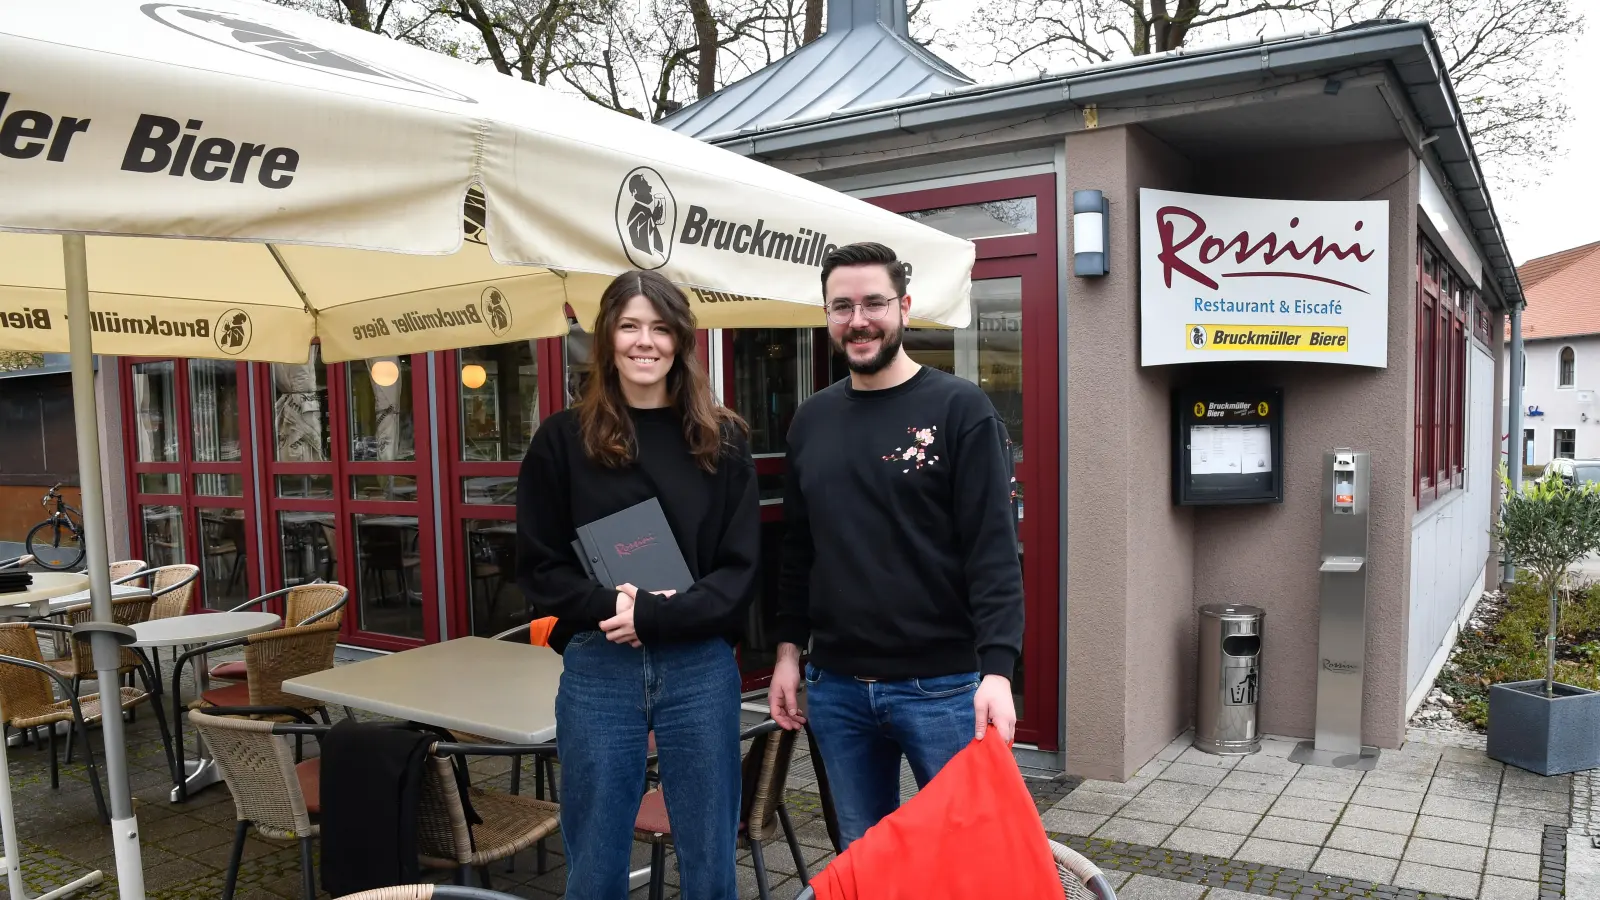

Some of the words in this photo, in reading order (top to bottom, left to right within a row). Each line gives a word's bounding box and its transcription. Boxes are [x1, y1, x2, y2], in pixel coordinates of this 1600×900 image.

[120, 113, 300, 190] Biere
[1156, 205, 1375, 291] Rossini
[1194, 297, 1275, 313] Restaurant
[1279, 300, 1290, 314] &
[1295, 299, 1342, 315] Eiscafé
[1212, 330, 1302, 346] Bruckmüller
[1309, 332, 1347, 347] Biere
[1206, 409, 1225, 418] Biere
[1208, 401, 1252, 410] Bruckmüller
